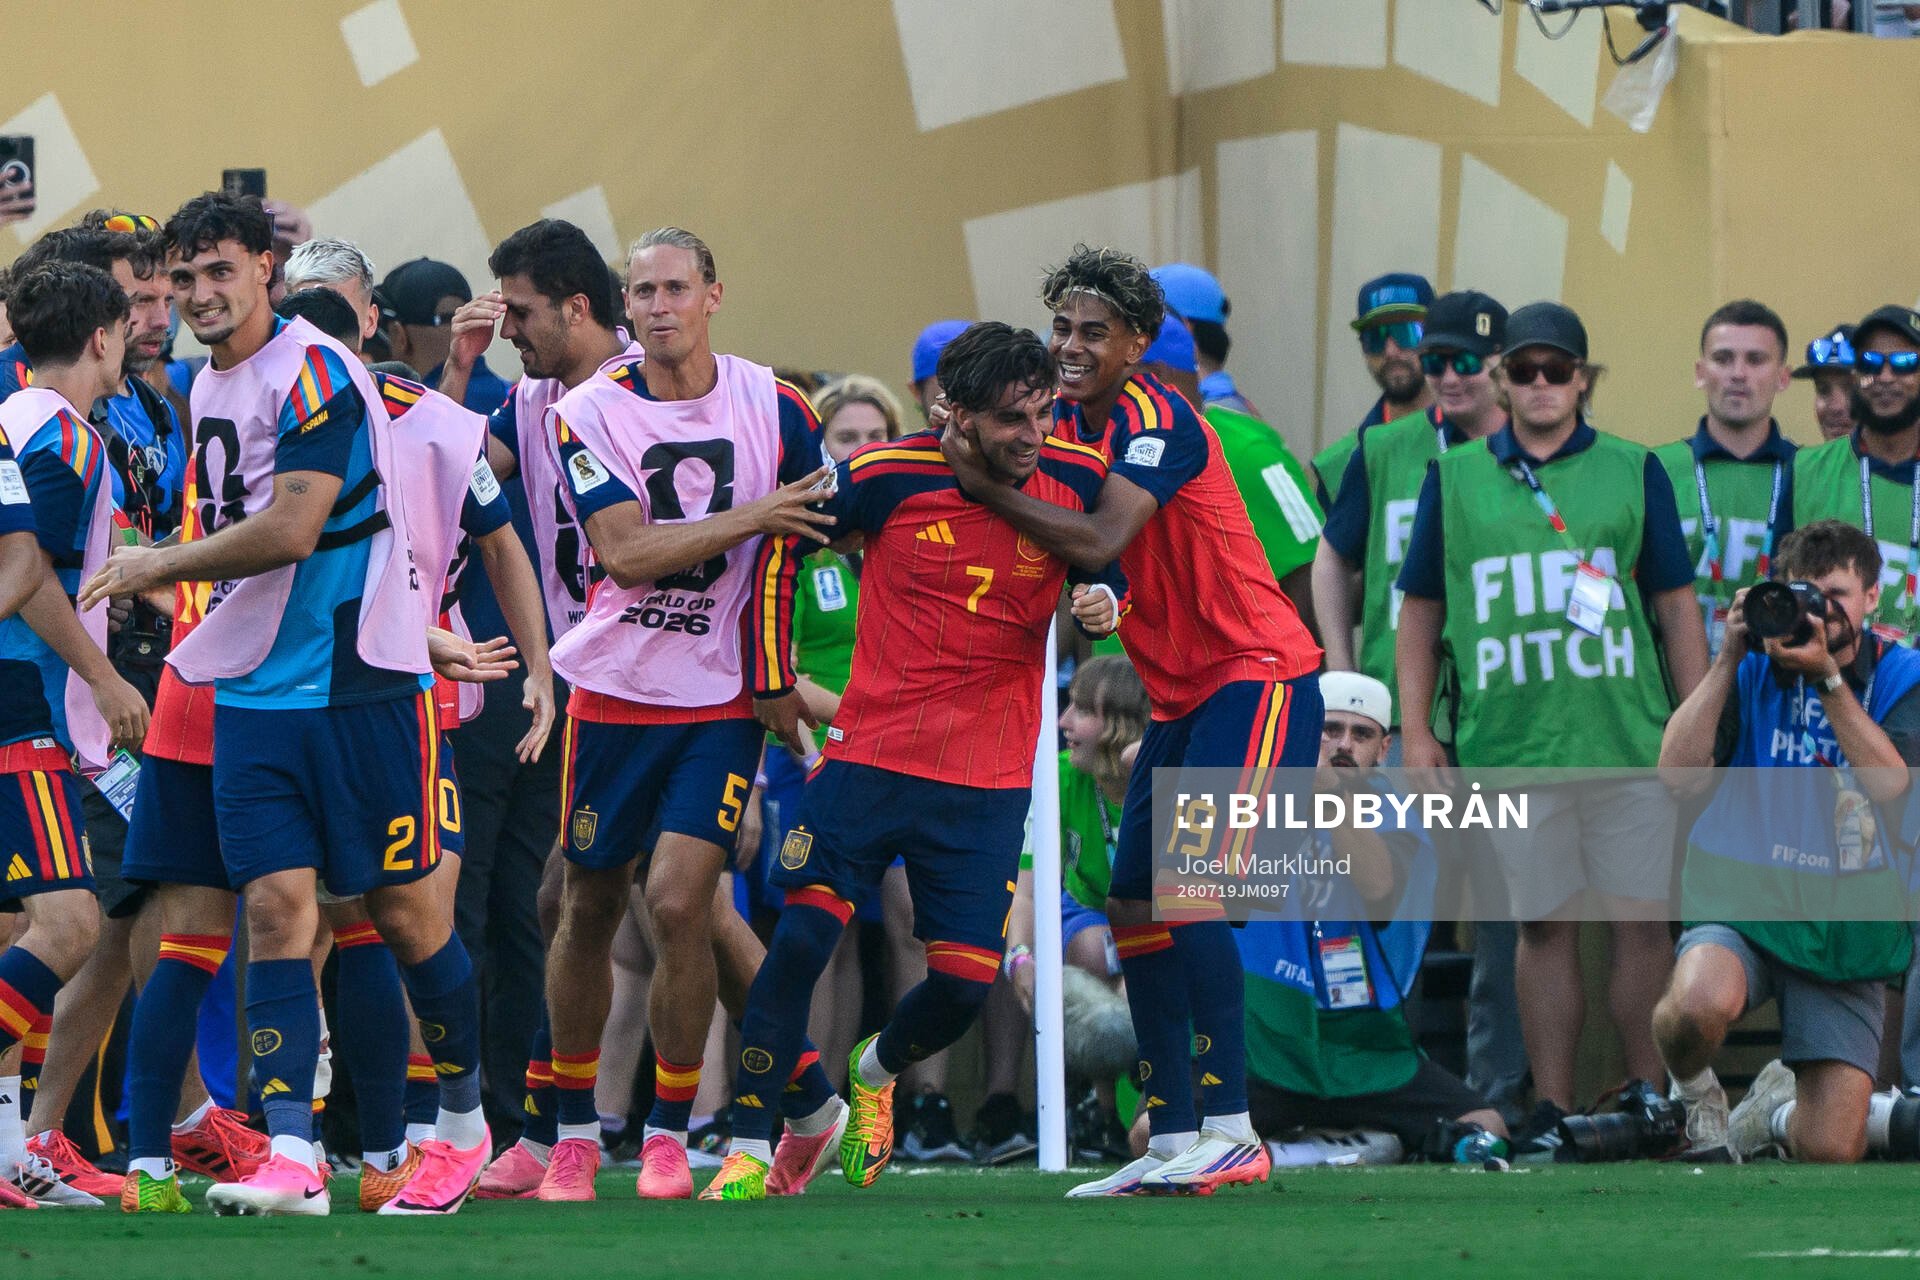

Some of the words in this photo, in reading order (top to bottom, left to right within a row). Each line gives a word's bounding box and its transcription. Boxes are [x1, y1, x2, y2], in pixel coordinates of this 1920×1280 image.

[639, 594, 686, 608] RLD
[966, 565, 995, 613] 7
[1472, 548, 1626, 624] FIFA
[618, 607, 712, 636] 2026
[1476, 626, 1635, 691] PITCH
[717, 772, 749, 832] 5
[1166, 799, 1218, 857] 19
[383, 815, 416, 871] 2
